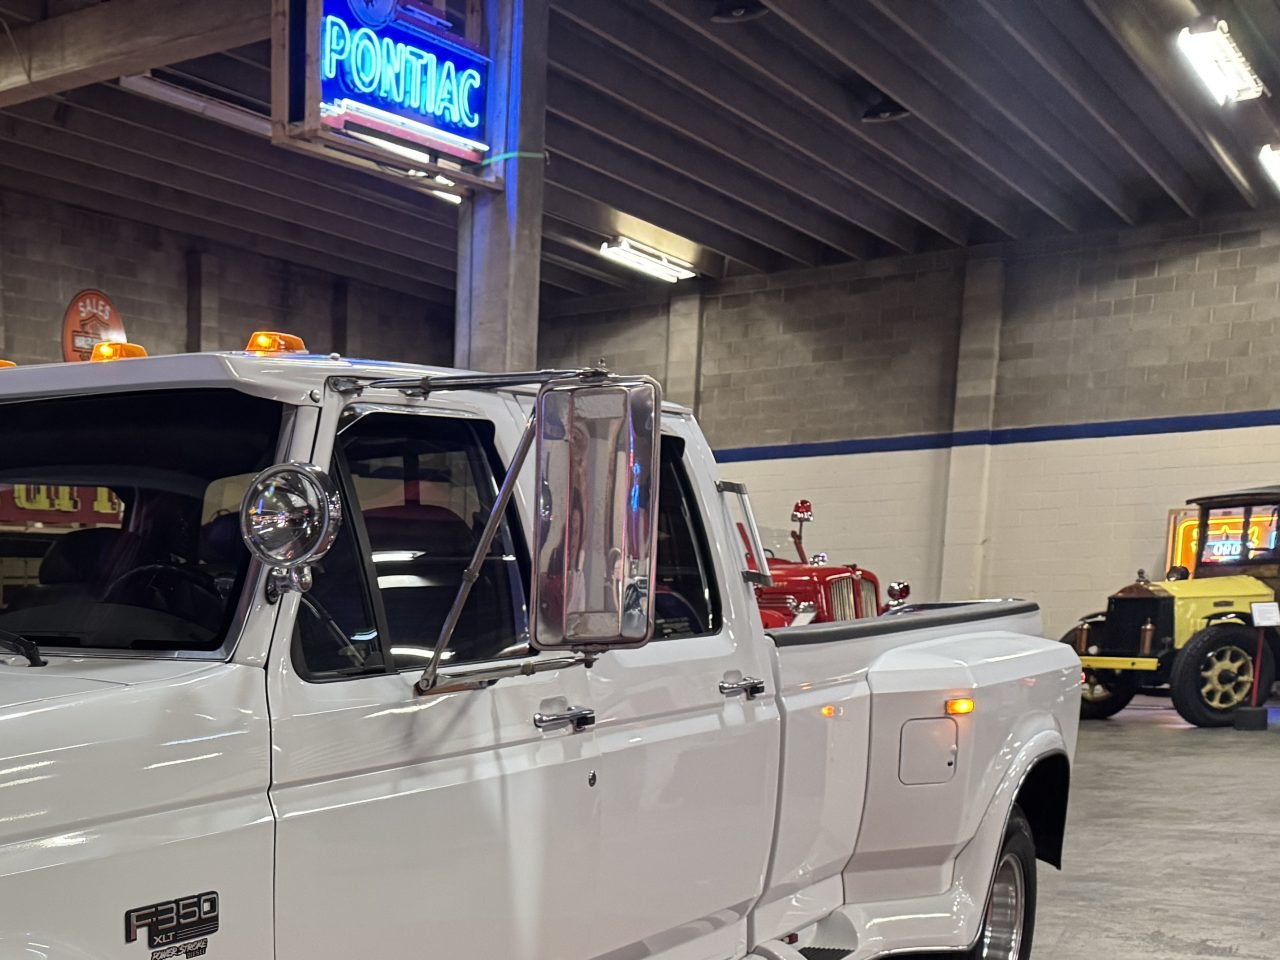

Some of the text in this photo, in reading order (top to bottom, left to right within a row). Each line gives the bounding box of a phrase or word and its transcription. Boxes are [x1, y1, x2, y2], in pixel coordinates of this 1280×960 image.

[324, 14, 481, 128] PONTIAC
[78, 298, 111, 321] SALES
[153, 931, 176, 945] XLT
[179, 938, 208, 955] STROKE
